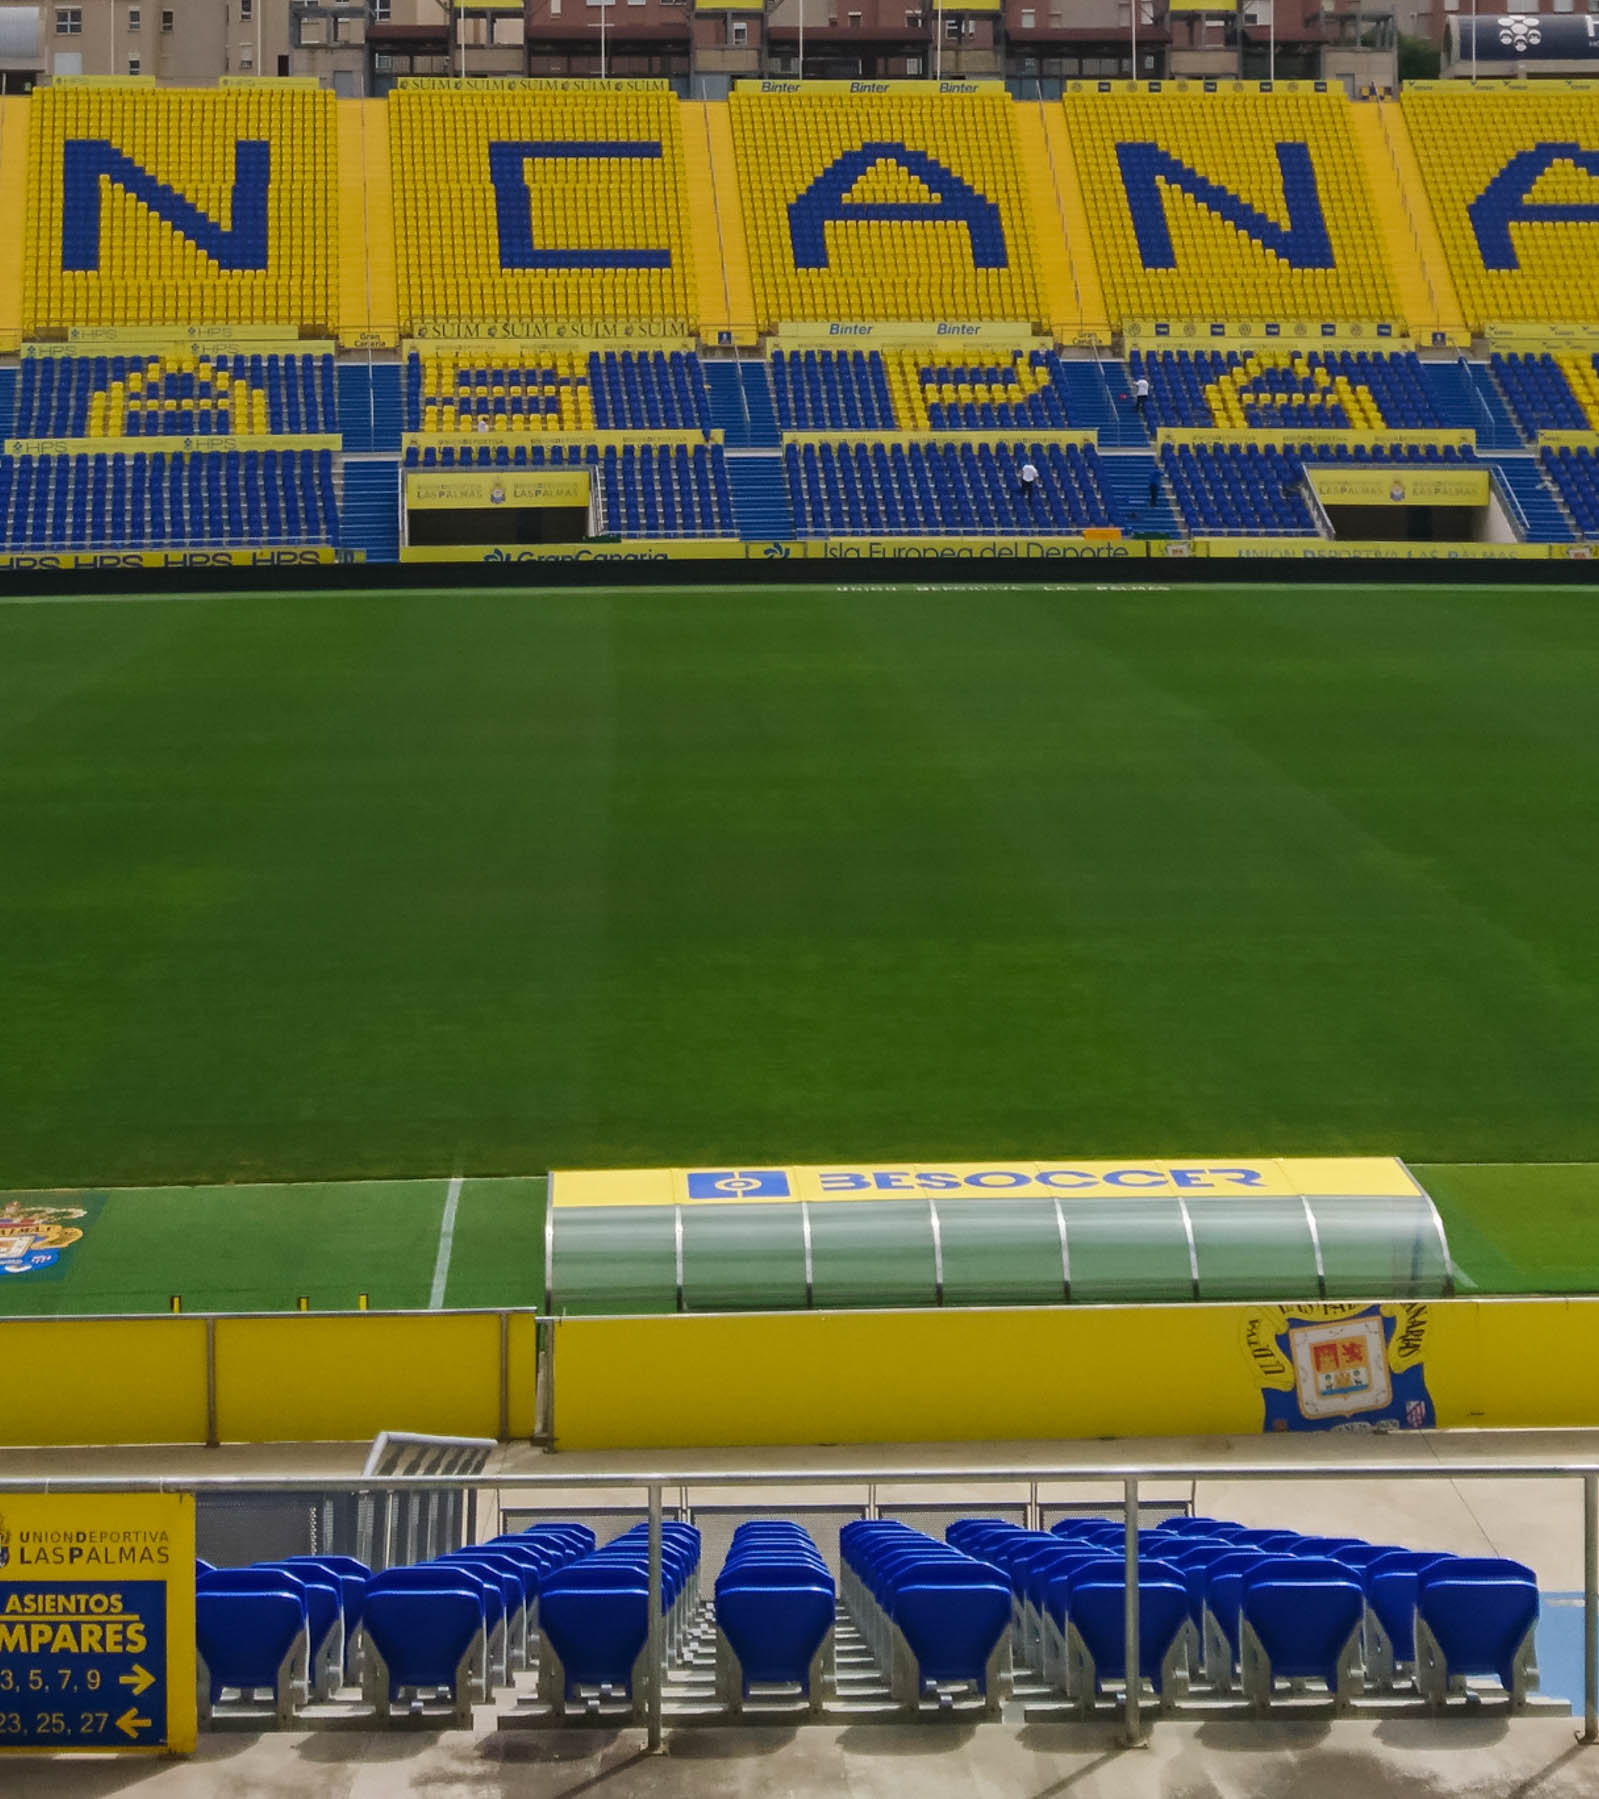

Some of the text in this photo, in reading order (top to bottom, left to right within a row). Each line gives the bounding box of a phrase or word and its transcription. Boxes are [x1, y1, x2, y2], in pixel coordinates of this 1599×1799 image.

[761, 82, 800, 94] Binter
[850, 82, 890, 94] Binter
[939, 82, 978, 94] Binter
[829, 324, 872, 336] Binter
[937, 324, 981, 336] Binter
[26, 442, 68, 454] HPS
[195, 438, 236, 450] HPS
[819, 1168, 1269, 1192] BESOCCER
[4, 1593, 124, 1614] ASIENTOS
[0, 1670, 21, 1694] 3,
[28, 1670, 49, 1694] 5,
[57, 1670, 78, 1694] 7,
[86, 1670, 101, 1690] 9
[36, 1713, 72, 1736] 25,
[80, 1712, 110, 1734] 27
